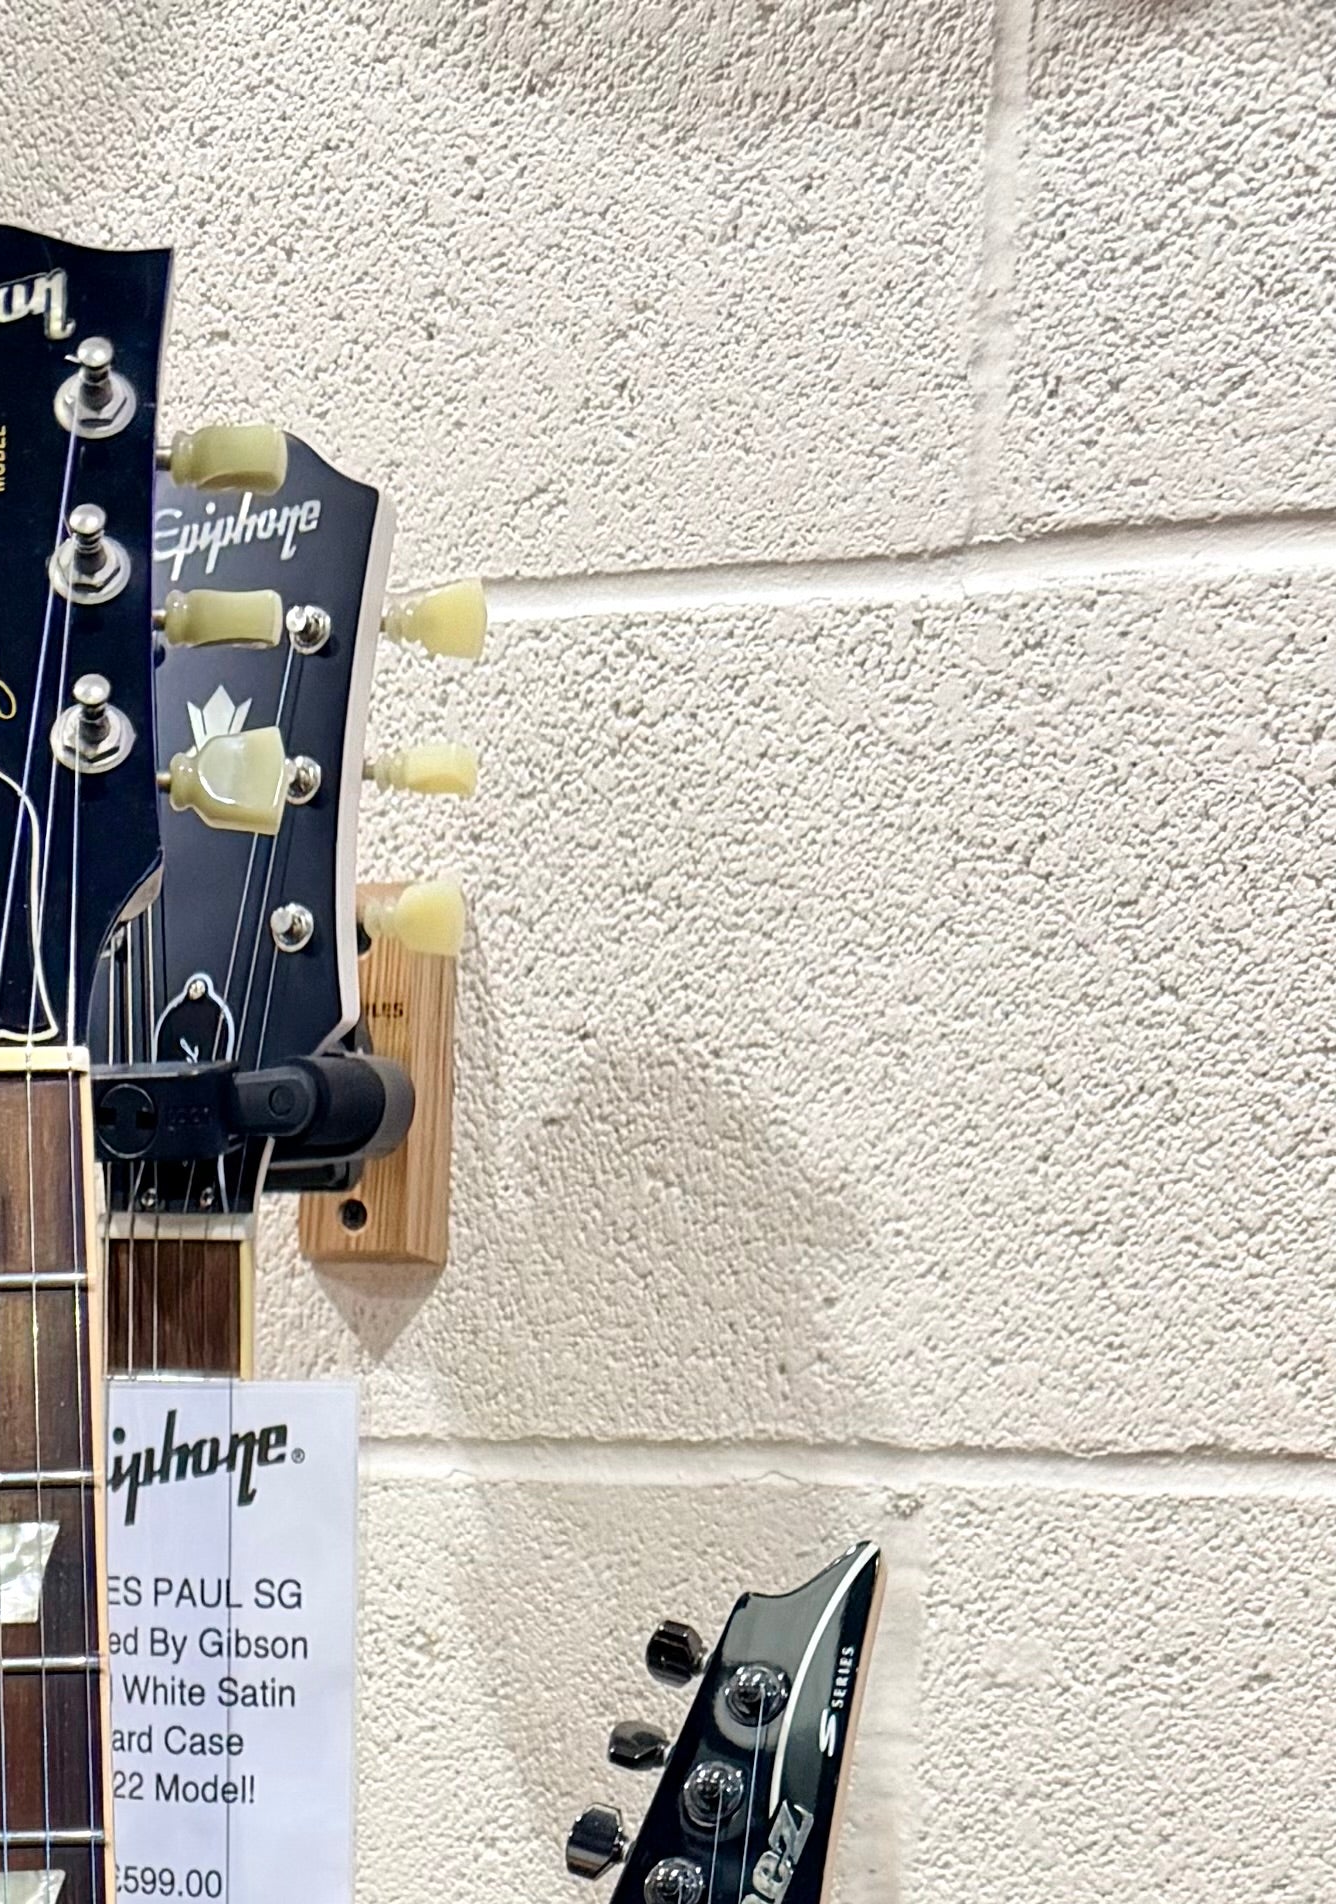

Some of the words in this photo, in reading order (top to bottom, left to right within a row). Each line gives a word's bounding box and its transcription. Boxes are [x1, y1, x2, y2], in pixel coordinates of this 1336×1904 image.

[153, 491, 320, 581] Epiphone
[107, 1576, 142, 1606] ES
[154, 1577, 243, 1609] PAUL
[254, 1578, 303, 1610] SG
[151, 1627, 187, 1664] By
[199, 1626, 308, 1659] Gibson
[123, 1674, 205, 1708] White
[218, 1677, 296, 1710] Satin
[819, 1708, 837, 1757] S
[831, 1646, 855, 1709] SERIES
[112, 1725, 152, 1753] ard
[164, 1725, 244, 1757] Case
[114, 1770, 144, 1800] 22
[155, 1773, 256, 1806] Model!
